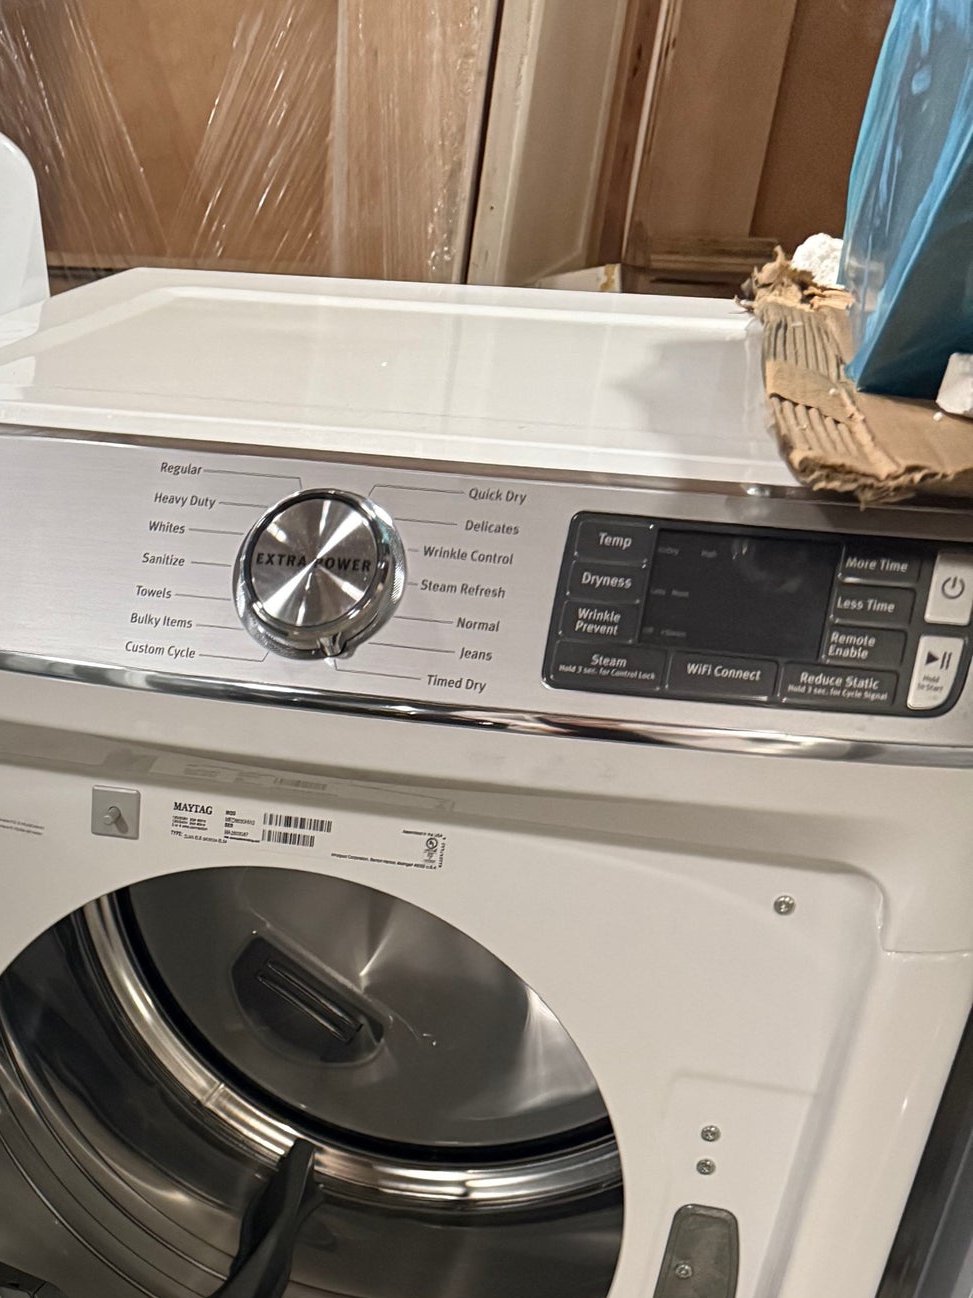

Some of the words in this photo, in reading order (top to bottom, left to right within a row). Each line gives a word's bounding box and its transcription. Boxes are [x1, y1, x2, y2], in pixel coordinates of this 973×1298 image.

[160, 461, 203, 476] Regular
[153, 492, 188, 508] Heavy
[189, 494, 216, 509] Duty
[468, 487, 503, 502] Quick
[505, 490, 527, 505] Dry
[148, 520, 185, 535] Whites
[464, 519, 520, 535] Delicates
[598, 532, 633, 551] Temp
[142, 552, 185, 567] Sanitize
[256, 552, 310, 568] EXTRA
[313, 557, 372, 573] POWER
[423, 545, 468, 561] Wrinkle
[470, 550, 514, 565] Control
[845, 556, 877, 570] More
[879, 558, 908, 573] Time
[420, 578, 457, 594] Steam
[460, 583, 506, 599] Refresh
[581, 571, 632, 589] Dryness
[136, 585, 172, 599] Towels
[836, 596, 864, 611] Less
[867, 598, 895, 613] Time
[130, 612, 161, 629] Bulky
[162, 615, 193, 629] Items
[577, 607, 621, 623] Wrinkle
[456, 617, 500, 632] Normal
[574, 620, 619, 636] Prevent
[830, 631, 876, 647] Remote
[125, 640, 165, 656] Custom
[167, 645, 196, 660] Cycle
[459, 646, 493, 662] Jeans
[828, 644, 869, 659] Enable
[590, 654, 627, 668] Steam
[558, 664, 576, 674] Hold
[599, 667, 609, 676] for
[610, 669, 638, 679] Control
[638, 671, 656, 680] Lock
[686, 662, 712, 677] WiFi
[714, 665, 761, 681] Connect
[427, 674, 463, 690] Timed
[465, 678, 487, 694] Dry
[800, 672, 845, 687] Reduce
[846, 675, 880, 690] Static
[787, 684, 806, 694] Hold
[829, 687, 841, 696] for
[842, 689, 863, 699] Cycle
[863, 690, 888, 701] Signal
[173, 802, 213, 816] MAYTAG
